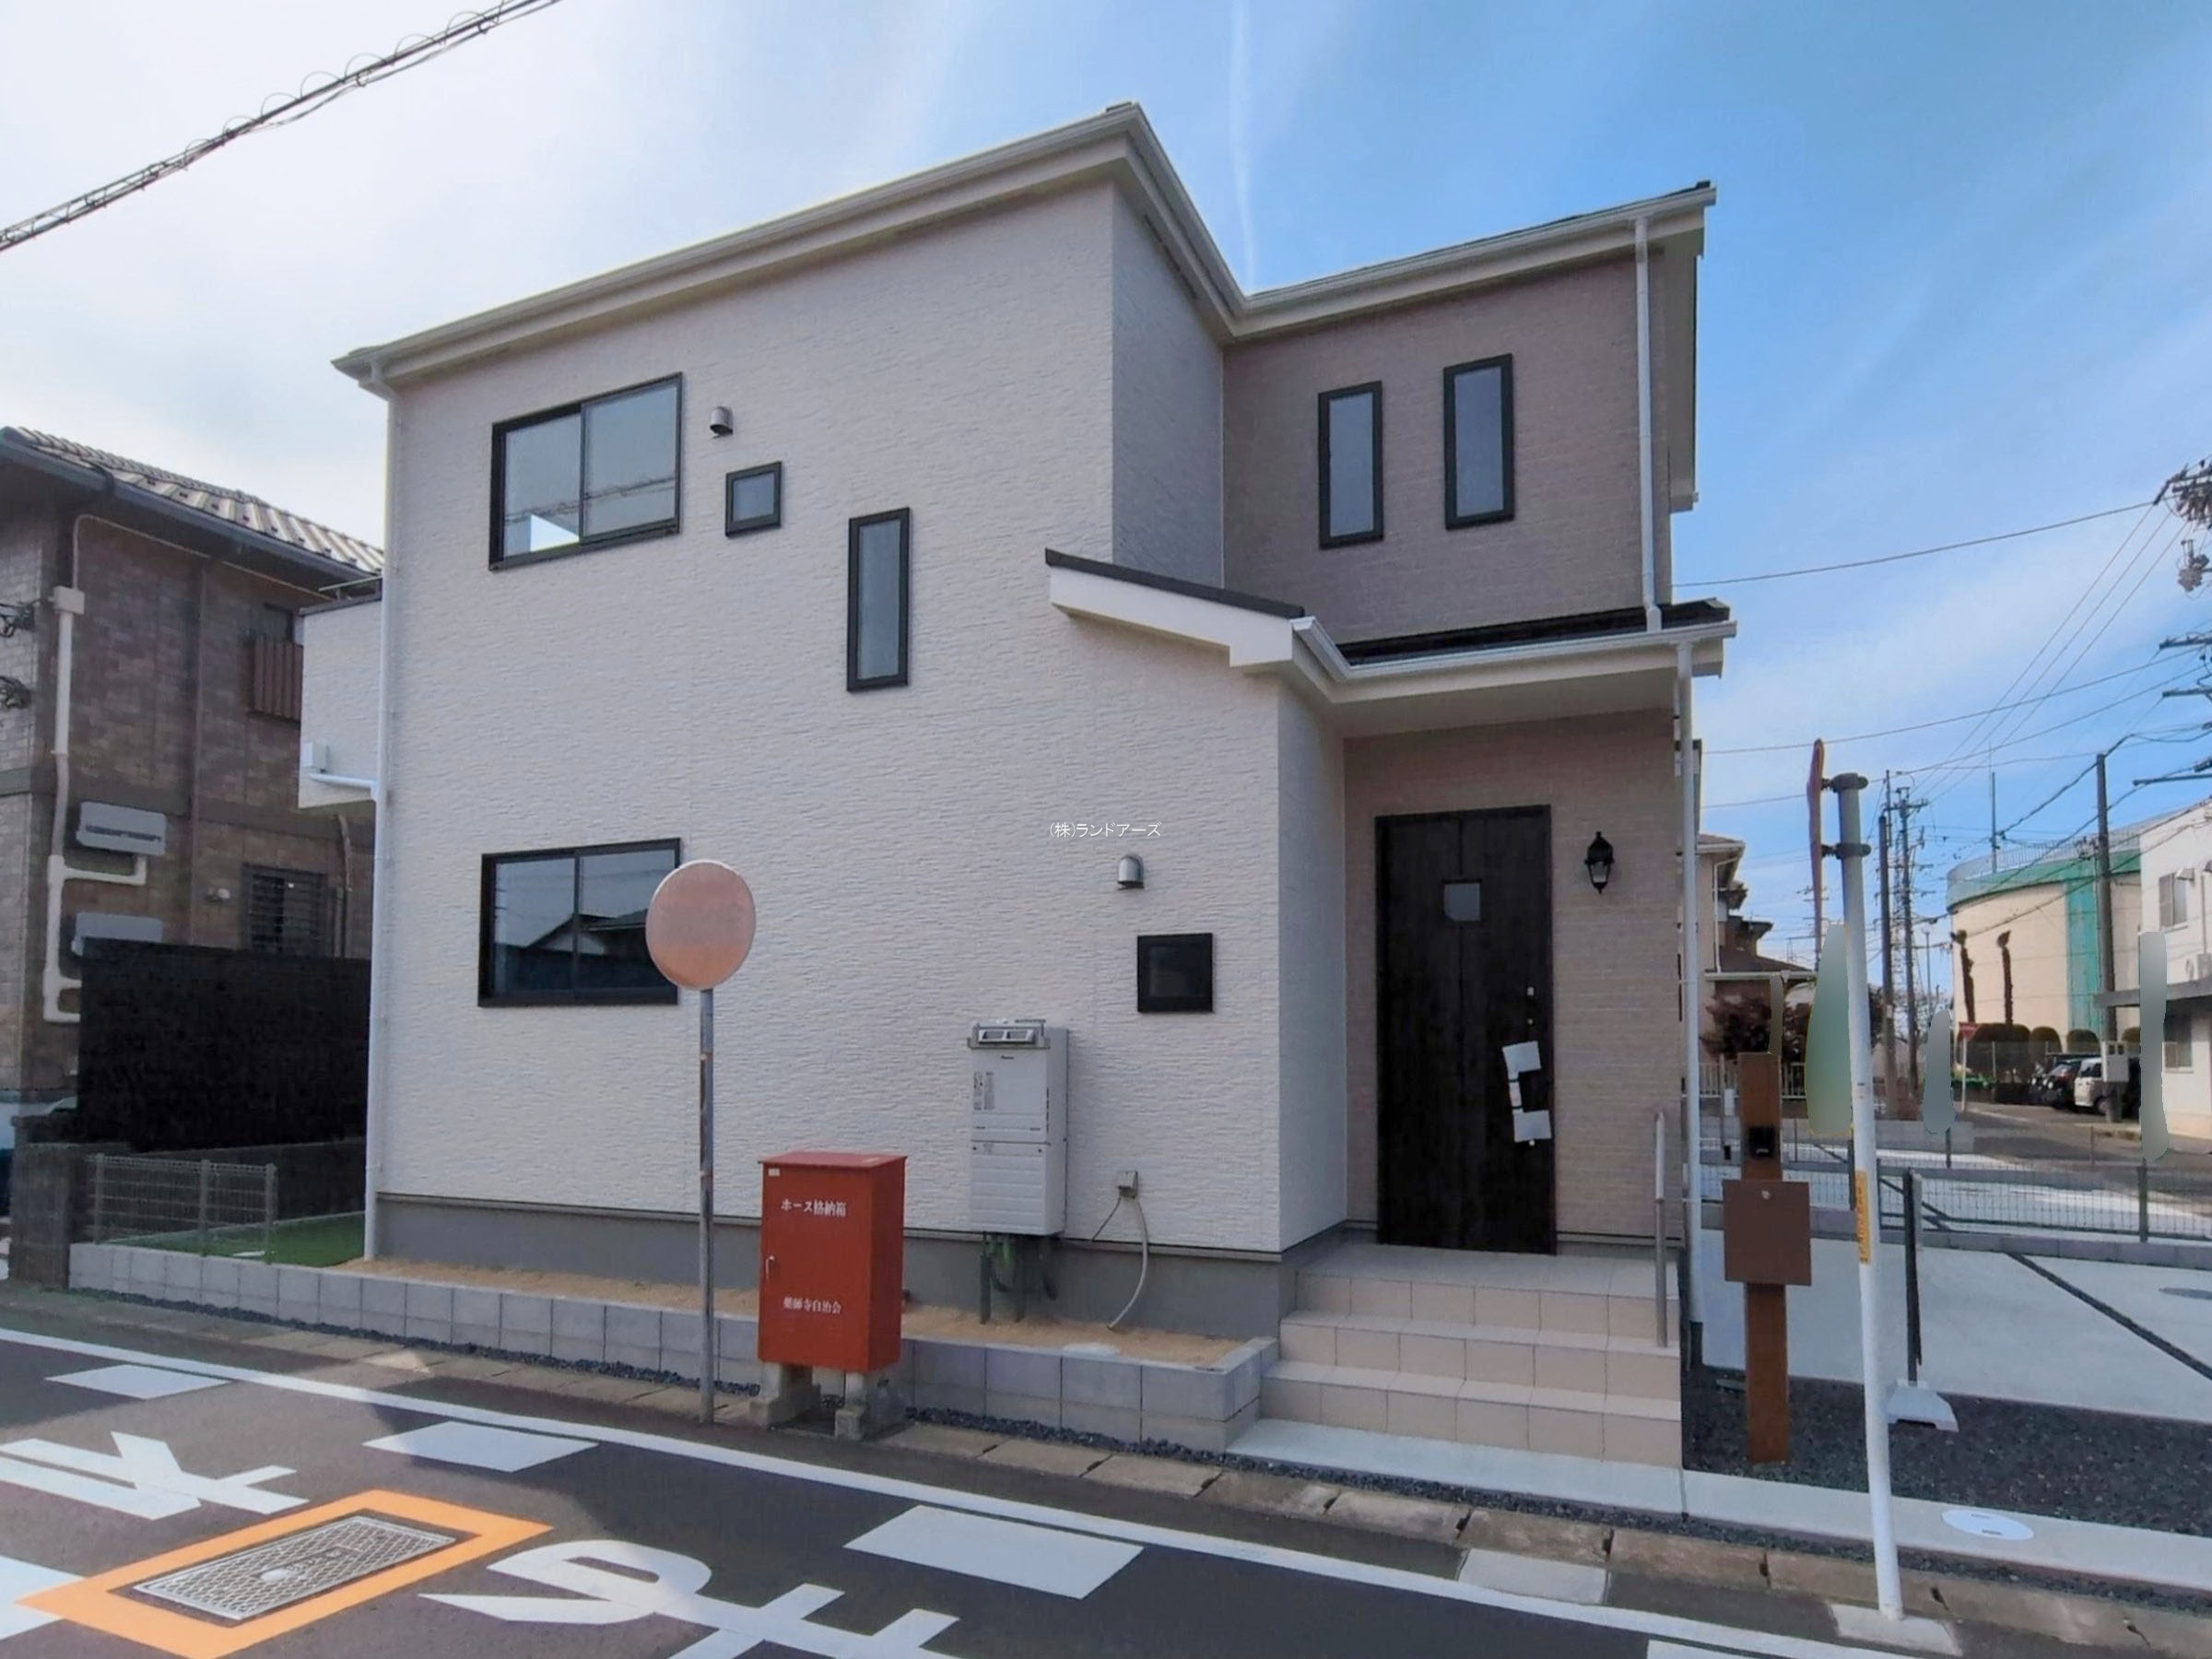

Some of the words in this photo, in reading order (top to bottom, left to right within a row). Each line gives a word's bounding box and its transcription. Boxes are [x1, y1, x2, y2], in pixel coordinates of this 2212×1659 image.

[781, 1198, 847, 1218] ホース格納箱
